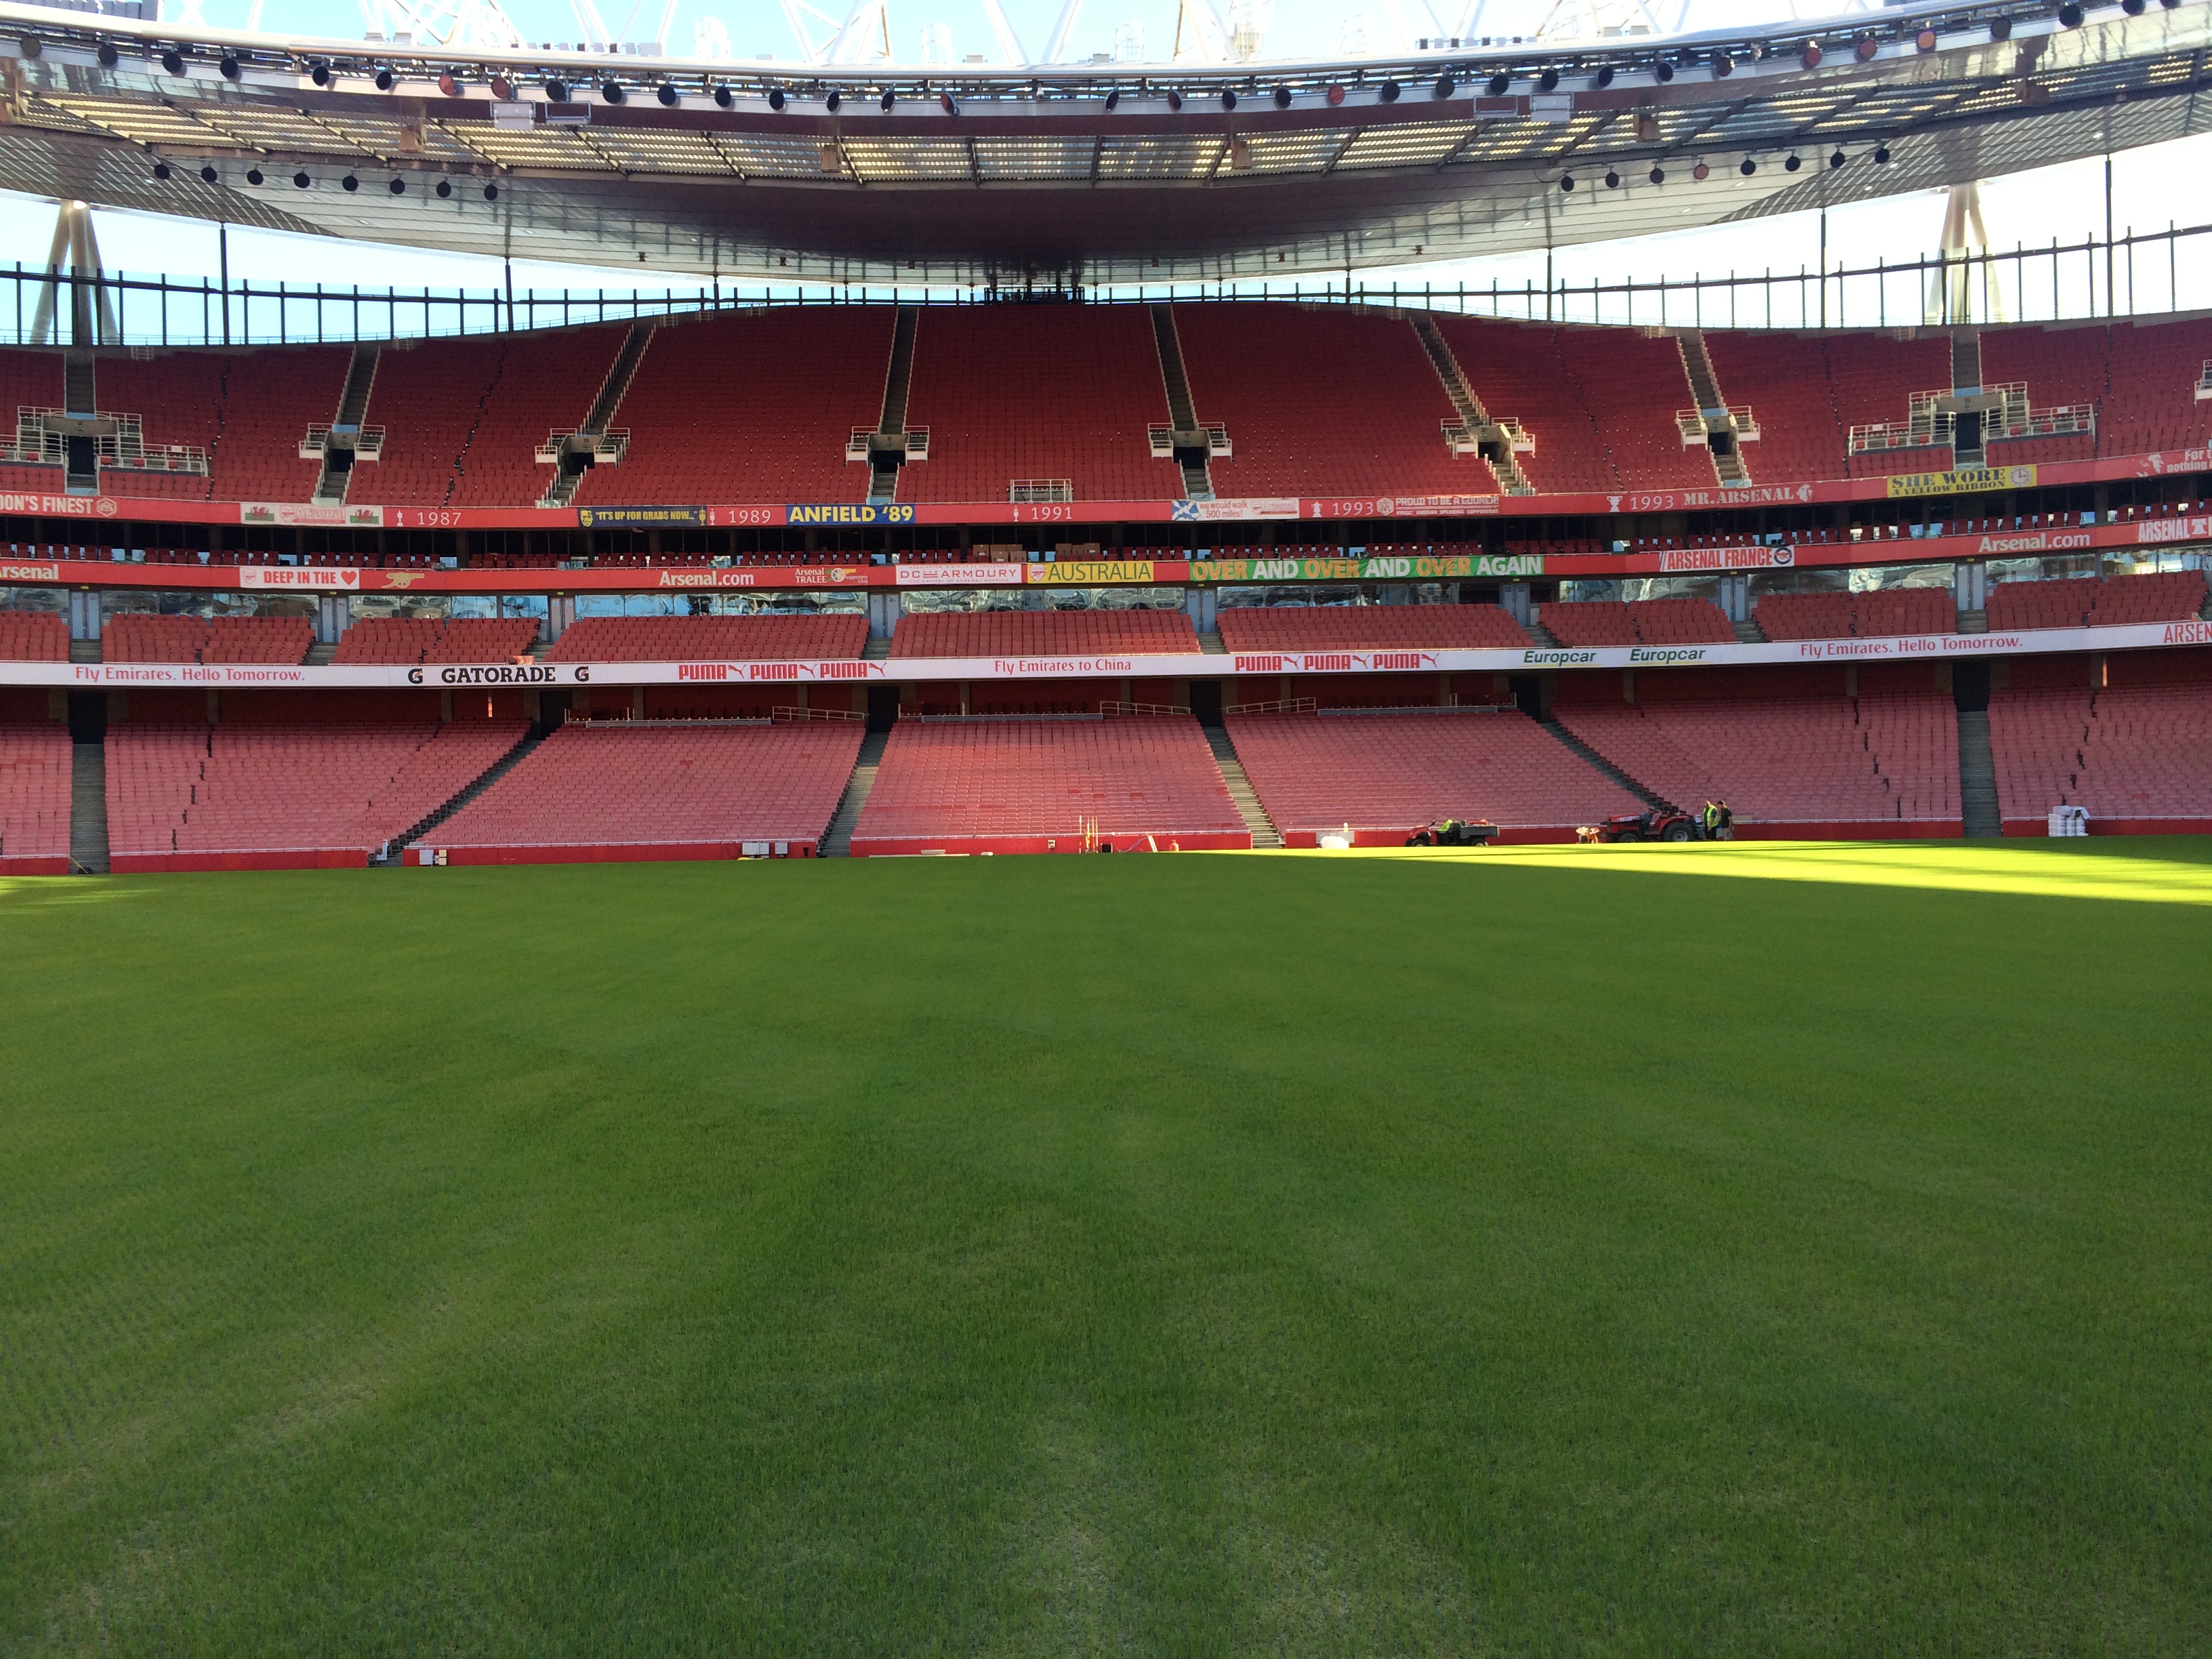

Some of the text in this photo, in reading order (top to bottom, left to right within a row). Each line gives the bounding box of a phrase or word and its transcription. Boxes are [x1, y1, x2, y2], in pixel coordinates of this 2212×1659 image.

[2185, 449, 2205, 461] For
[2167, 461, 2207, 472] nothing
[1891, 468, 2005, 488] SHE WORE
[1904, 485, 1951, 495] YELLOW
[1956, 480, 2005, 491] RIBBON
[42, 497, 94, 514] FINEST
[1210, 501, 1231, 509] would
[1332, 501, 1374, 516] 1993
[1395, 497, 1425, 506] PROUD
[1440, 497, 1452, 505] BE
[1453, 497, 1460, 505] A
[1630, 495, 1674, 510] 1993
[295, 505, 346, 519] Arsenal
[417, 512, 462, 526] 1987
[615, 512, 626, 520] UP
[627, 512, 642, 520] FOR
[642, 512, 669, 520] GRABS
[729, 510, 771, 524] 1989
[790, 506, 876, 523] ANFIELD
[1031, 506, 1073, 520] 1991
[1222, 510, 1243, 518] miles!
[2138, 518, 2190, 542] ARSENAL
[1978, 533, 2090, 553] Arsenal.com
[1667, 548, 1773, 570] ARSENAL FRANCE
[0, 564, 59, 580] rsenal
[795, 567, 825, 576] Arsenal
[941, 569, 1017, 578] ARMOURY
[1048, 563, 1152, 581] AUSTRALIA
[1193, 556, 1541, 580] OVER AND OVER AND OVER AGAIN
[263, 571, 336, 584] DEEP IN THE
[659, 571, 754, 586] Arsenal.com
[795, 575, 827, 583] TRALEE
[2163, 623, 2212, 643] ARSEN
[1800, 637, 2023, 659] Fly Emirates. Hello Tomorrow.
[1235, 656, 1282, 672] PUMA
[1304, 655, 1351, 670] PUMA
[1373, 653, 1420, 670] PUMA
[1523, 651, 1597, 666] Europcar
[1630, 649, 1706, 664] Europcar
[75, 666, 305, 682] Fly Emirates. Hello Tomorrow.
[575, 665, 590, 682] G
[678, 664, 727, 680] PUMA
[750, 663, 798, 679] PUMA
[819, 662, 868, 678] PUMA
[994, 659, 1132, 675] Fly Emirates to China
[408, 668, 424, 684] G
[441, 666, 556, 684] GATORADE
